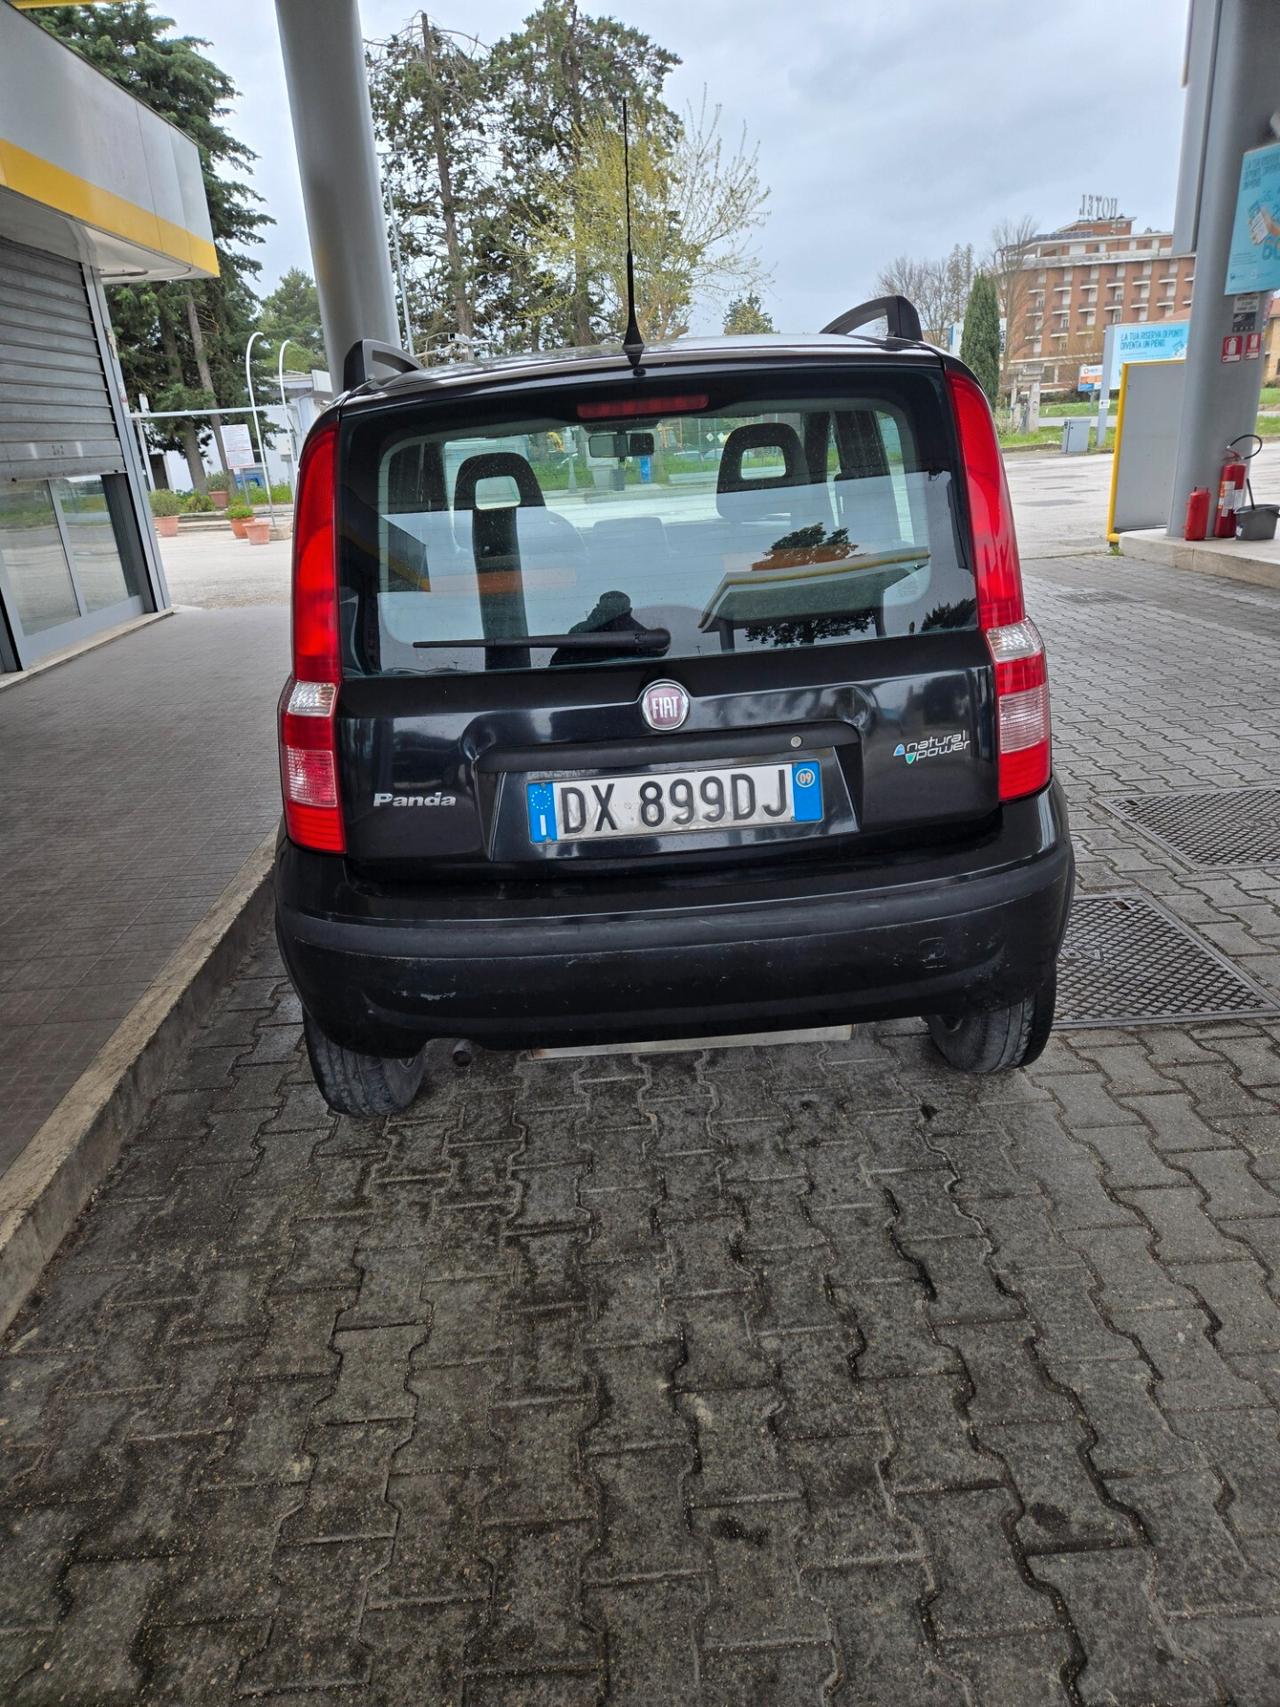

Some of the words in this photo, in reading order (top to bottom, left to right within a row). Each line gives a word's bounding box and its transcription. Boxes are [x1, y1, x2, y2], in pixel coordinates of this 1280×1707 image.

[652, 696, 679, 720] FIAT
[906, 729, 966, 752] natural
[916, 740, 971, 761] power
[799, 772, 812, 784] 09
[373, 792, 457, 807] Panda
[560, 783, 618, 834] DX
[639, 769, 787, 827] 899DJ
